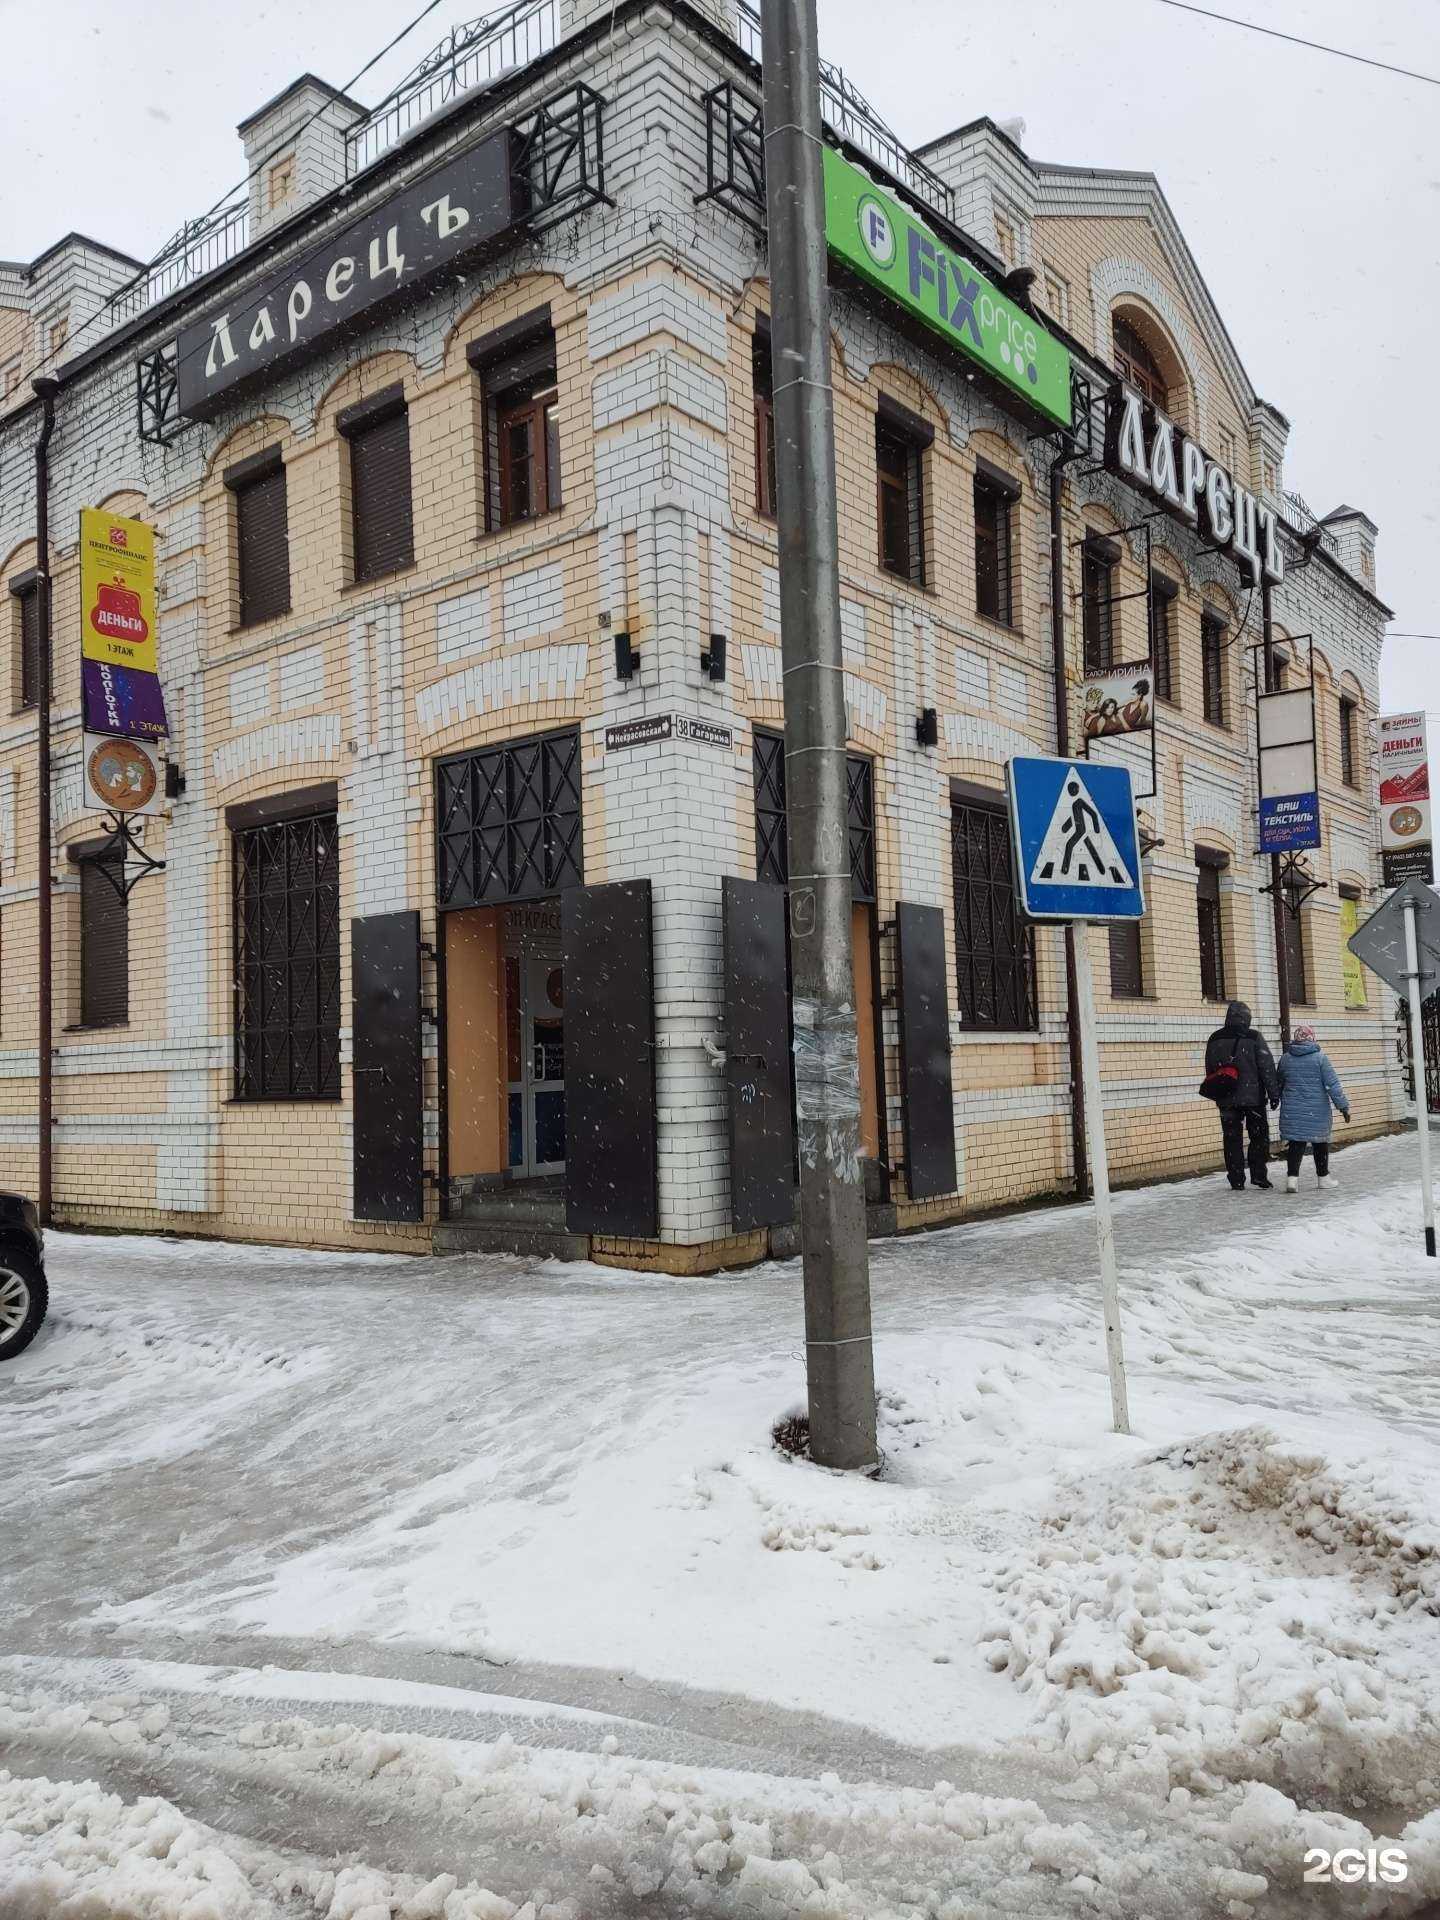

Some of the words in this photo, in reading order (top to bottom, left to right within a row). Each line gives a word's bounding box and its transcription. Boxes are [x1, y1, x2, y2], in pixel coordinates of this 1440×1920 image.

[868, 207, 886, 249] F
[204, 193, 471, 379] Ларецъ
[979, 294, 1038, 362] price
[97, 610, 143, 632] ДЕНЬГИ
[112, 645, 134, 657] ЭТАЖ
[1085, 669, 1107, 679] САЛОН
[1108, 663, 1152, 681] ИРИНА
[129, 720, 136, 730] 1
[140, 721, 166, 734] ЭТАЖ
[615, 725, 662, 744] Некрасовская
[678, 718, 689, 736] 38
[690, 725, 729, 745] Гагарина
[1382, 736, 1424, 754] ДЕНЬГИ
[1382, 747, 1424, 759] НАЛИЧНЫМИ
[1276, 801, 1300, 812] ВАШ
[1263, 812, 1314, 826] ТЕКСТИЛЬ
